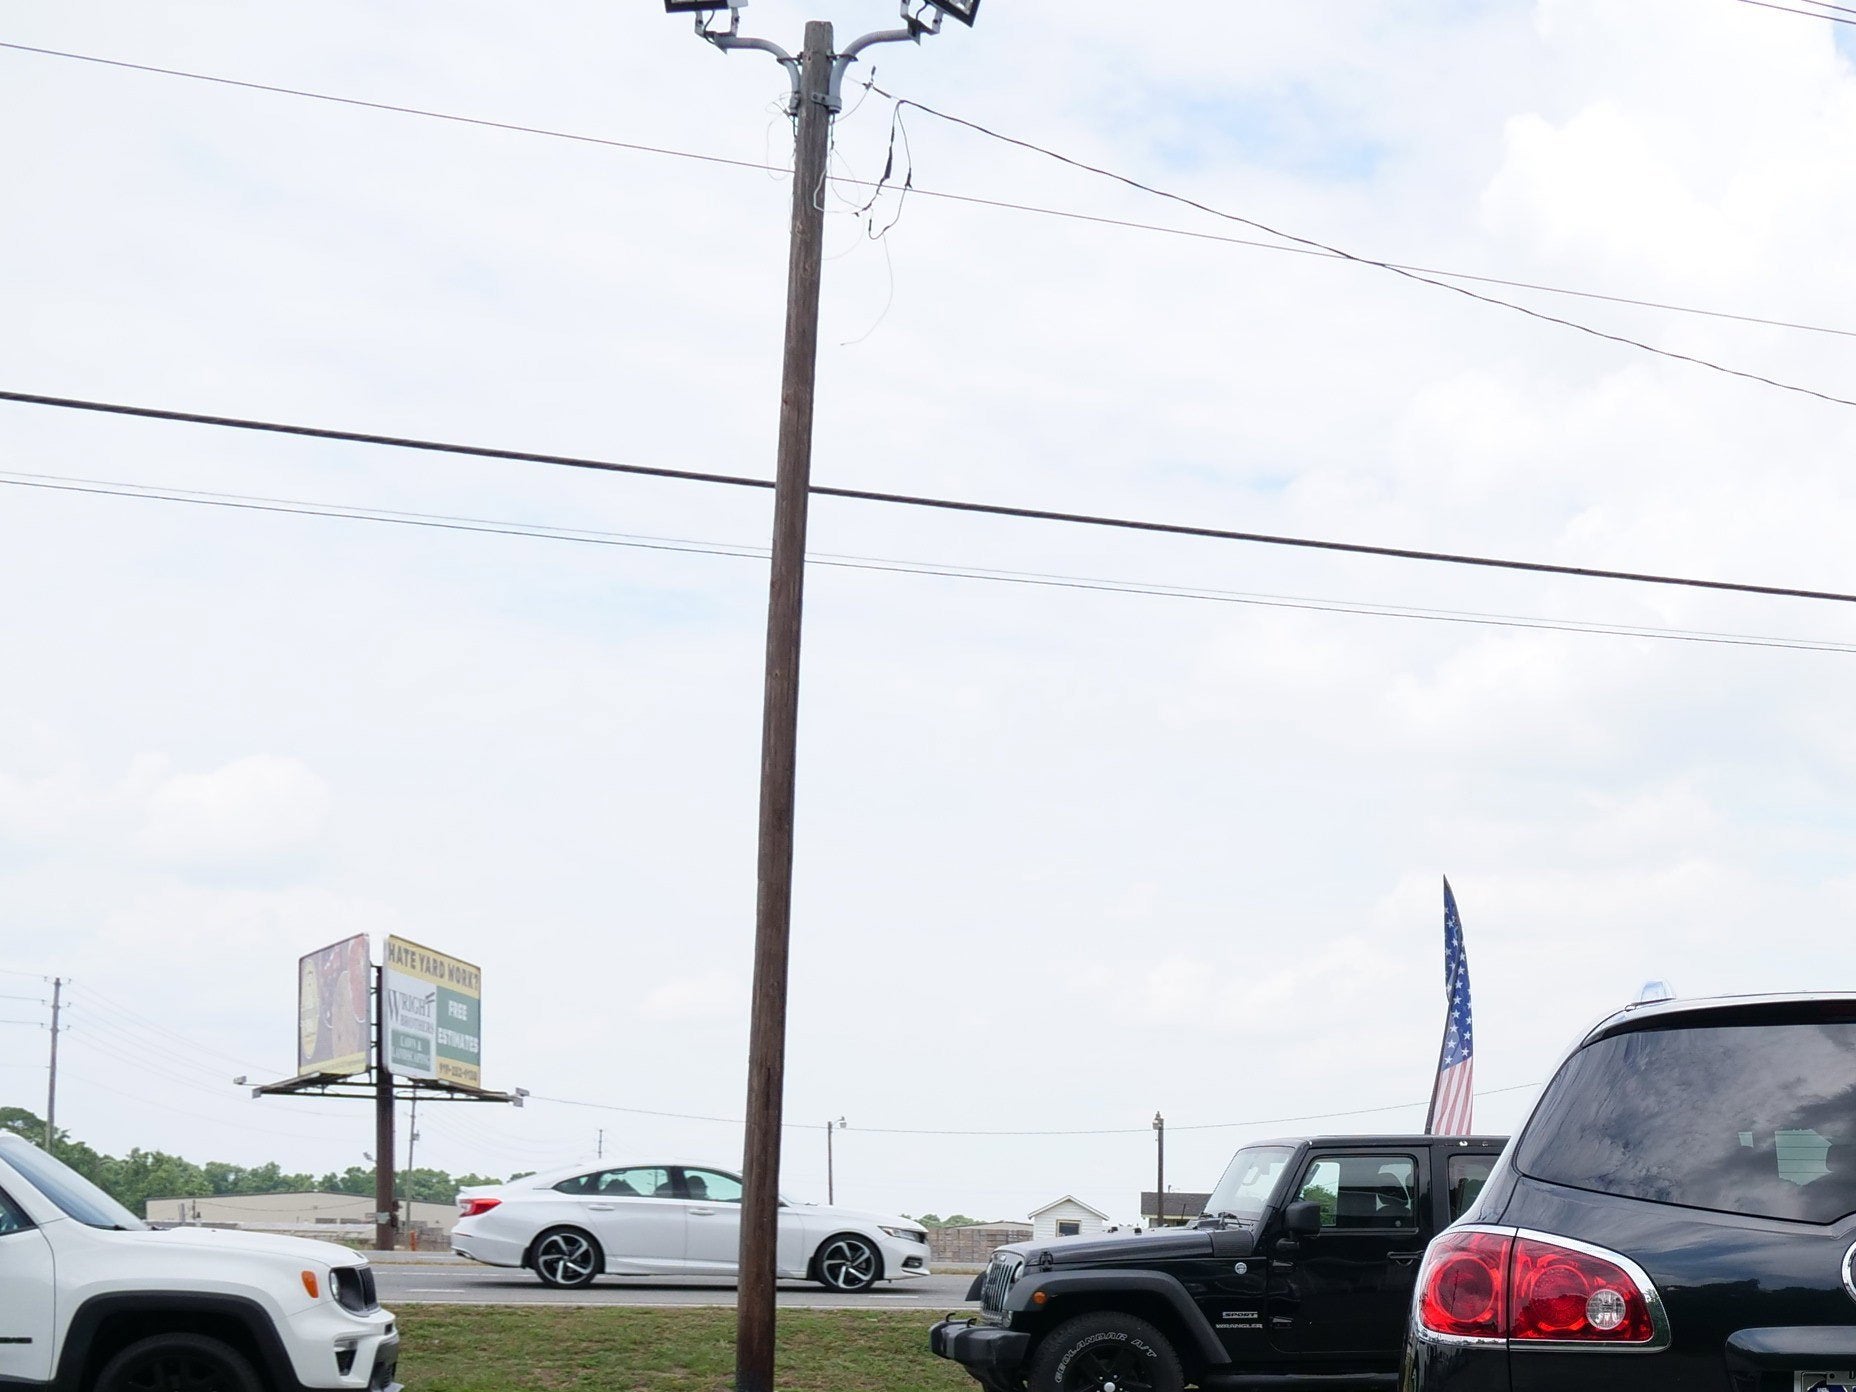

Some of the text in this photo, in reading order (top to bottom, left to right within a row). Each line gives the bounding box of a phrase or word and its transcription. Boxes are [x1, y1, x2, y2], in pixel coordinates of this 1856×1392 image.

[387, 941, 480, 991] HATE YARD WORK?
[448, 999, 468, 1022] FREE
[437, 1026, 479, 1053] ESTIMATES
[1055, 1332, 1157, 1383] GEOLANDAR A/T
